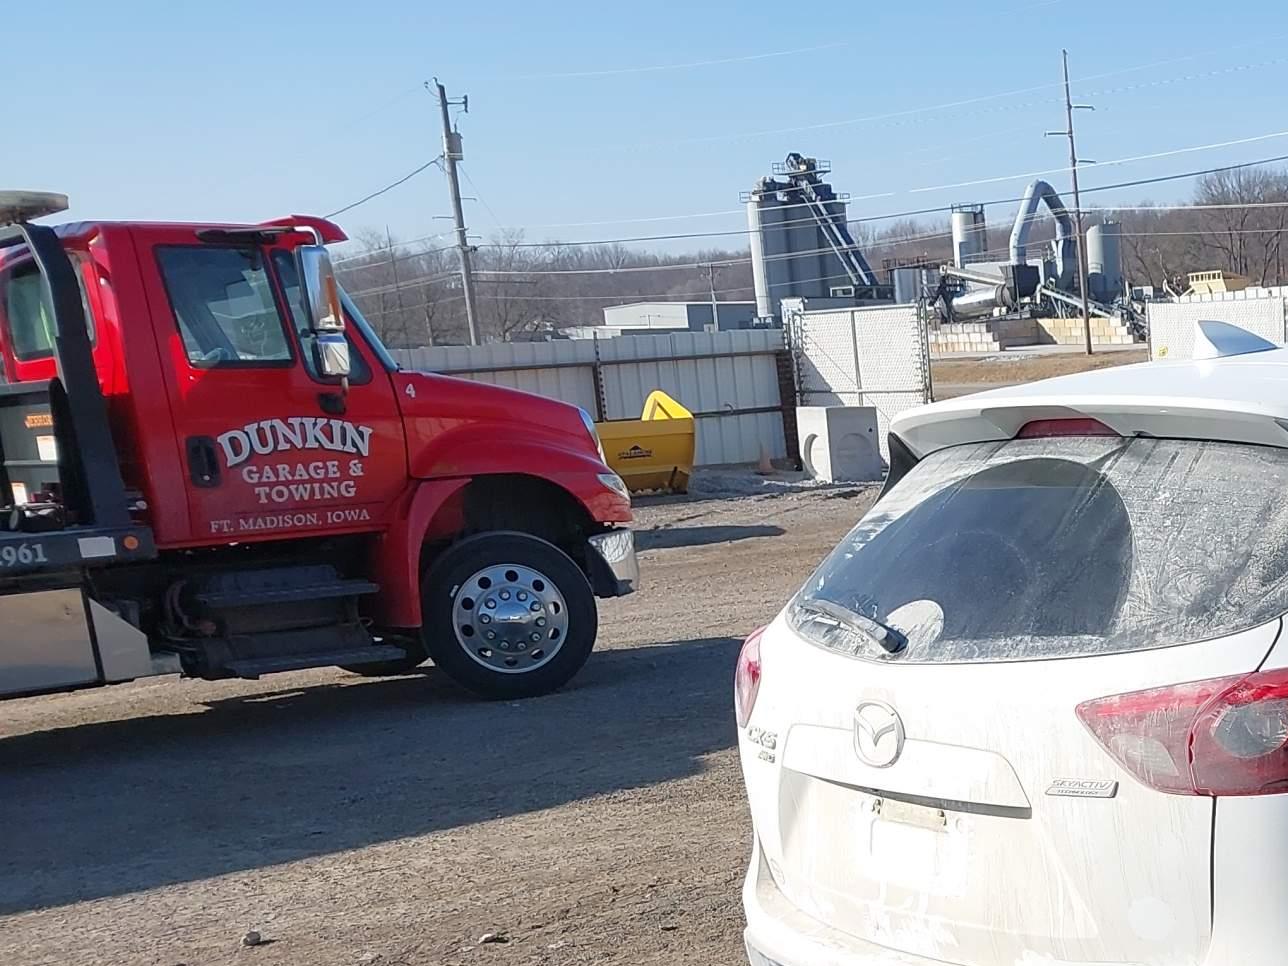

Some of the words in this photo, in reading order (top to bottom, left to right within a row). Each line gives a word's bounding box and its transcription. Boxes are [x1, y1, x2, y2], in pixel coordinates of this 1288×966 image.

[405, 383, 416, 398] 4
[217, 417, 373, 468] DUNKIN
[242, 460, 341, 484] GARAGE
[349, 459, 365, 477] &
[255, 480, 357, 504] TOWING
[210, 520, 234, 534] FT.
[239, 512, 323, 531] MADISON,
[327, 508, 371, 525] IOWA
[0, 543, 48, 568] 961
[1053, 779, 1109, 789] SKYACTIV
